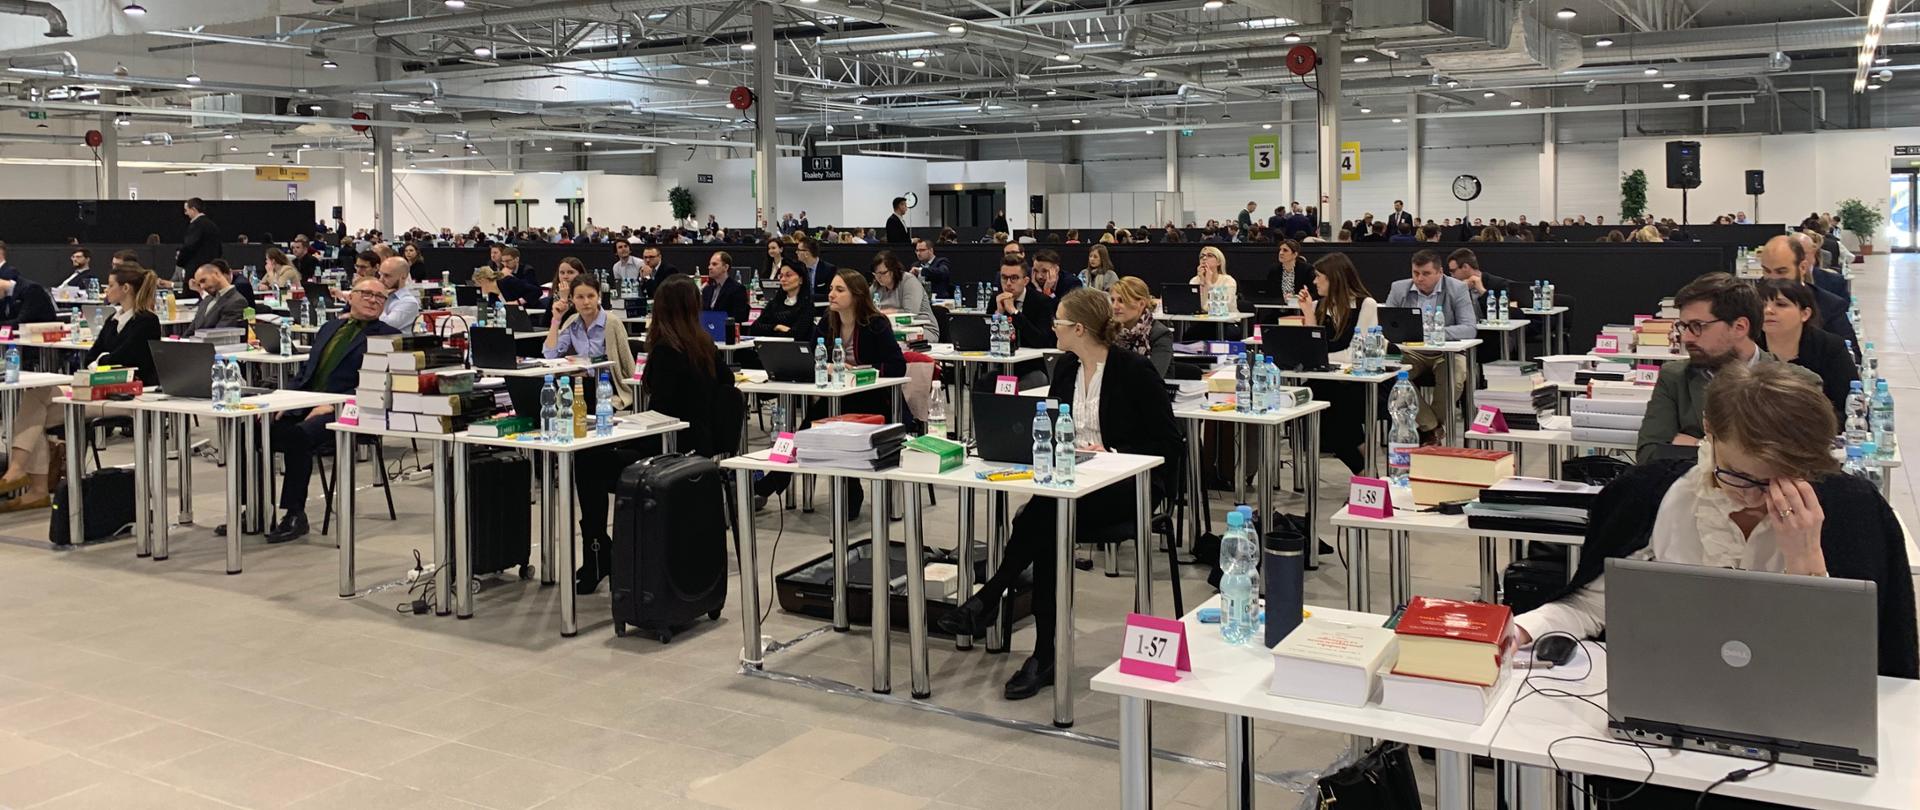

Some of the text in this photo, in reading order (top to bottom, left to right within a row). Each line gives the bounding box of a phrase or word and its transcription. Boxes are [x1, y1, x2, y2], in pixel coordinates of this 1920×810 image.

[1259, 151, 1270, 168] 3
[1341, 156, 1352, 170] 4
[803, 171, 841, 179] Toalety Toilets
[1001, 383, 1012, 393] 1-52
[1357, 488, 1377, 504] 1-58
[1136, 634, 1168, 658] 1-57
